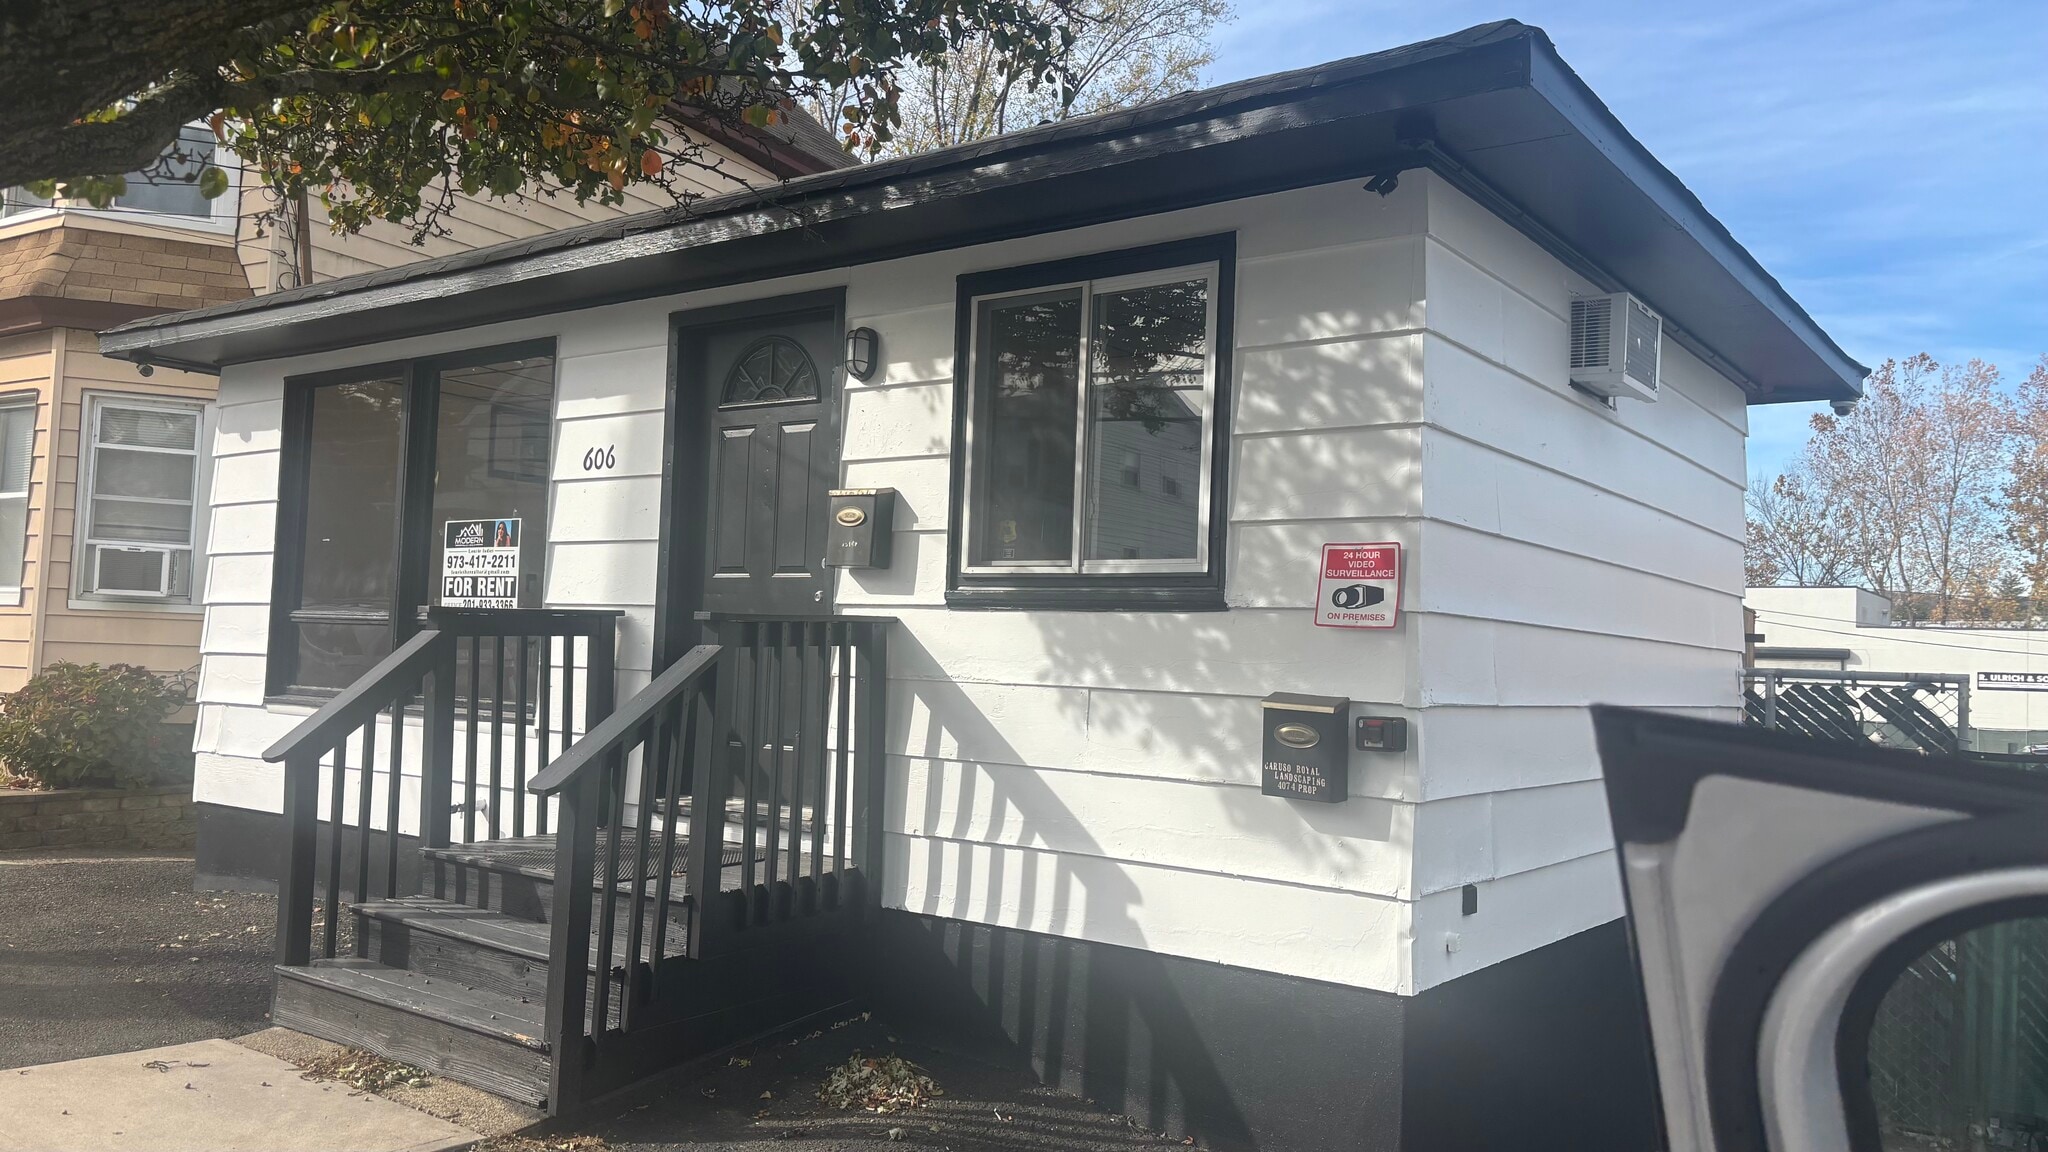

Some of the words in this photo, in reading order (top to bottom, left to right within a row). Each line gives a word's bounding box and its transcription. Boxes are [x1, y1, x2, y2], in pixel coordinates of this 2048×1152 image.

[583, 444, 615, 471] 606
[447, 555, 515, 568] 973-417-2211
[445, 577, 472, 596] FOR
[477, 577, 514, 596] RENT
[1343, 613, 1385, 621] PREMISES
[1990, 674, 2024, 682] ULRICH
[1265, 762, 1291, 772] CARUSO
[1296, 765, 1319, 775] ROYAL
[1274, 771, 1326, 787] LANDSCAPING
[1278, 781, 1295, 791] 4074
[1298, 784, 1317, 794] PROP
